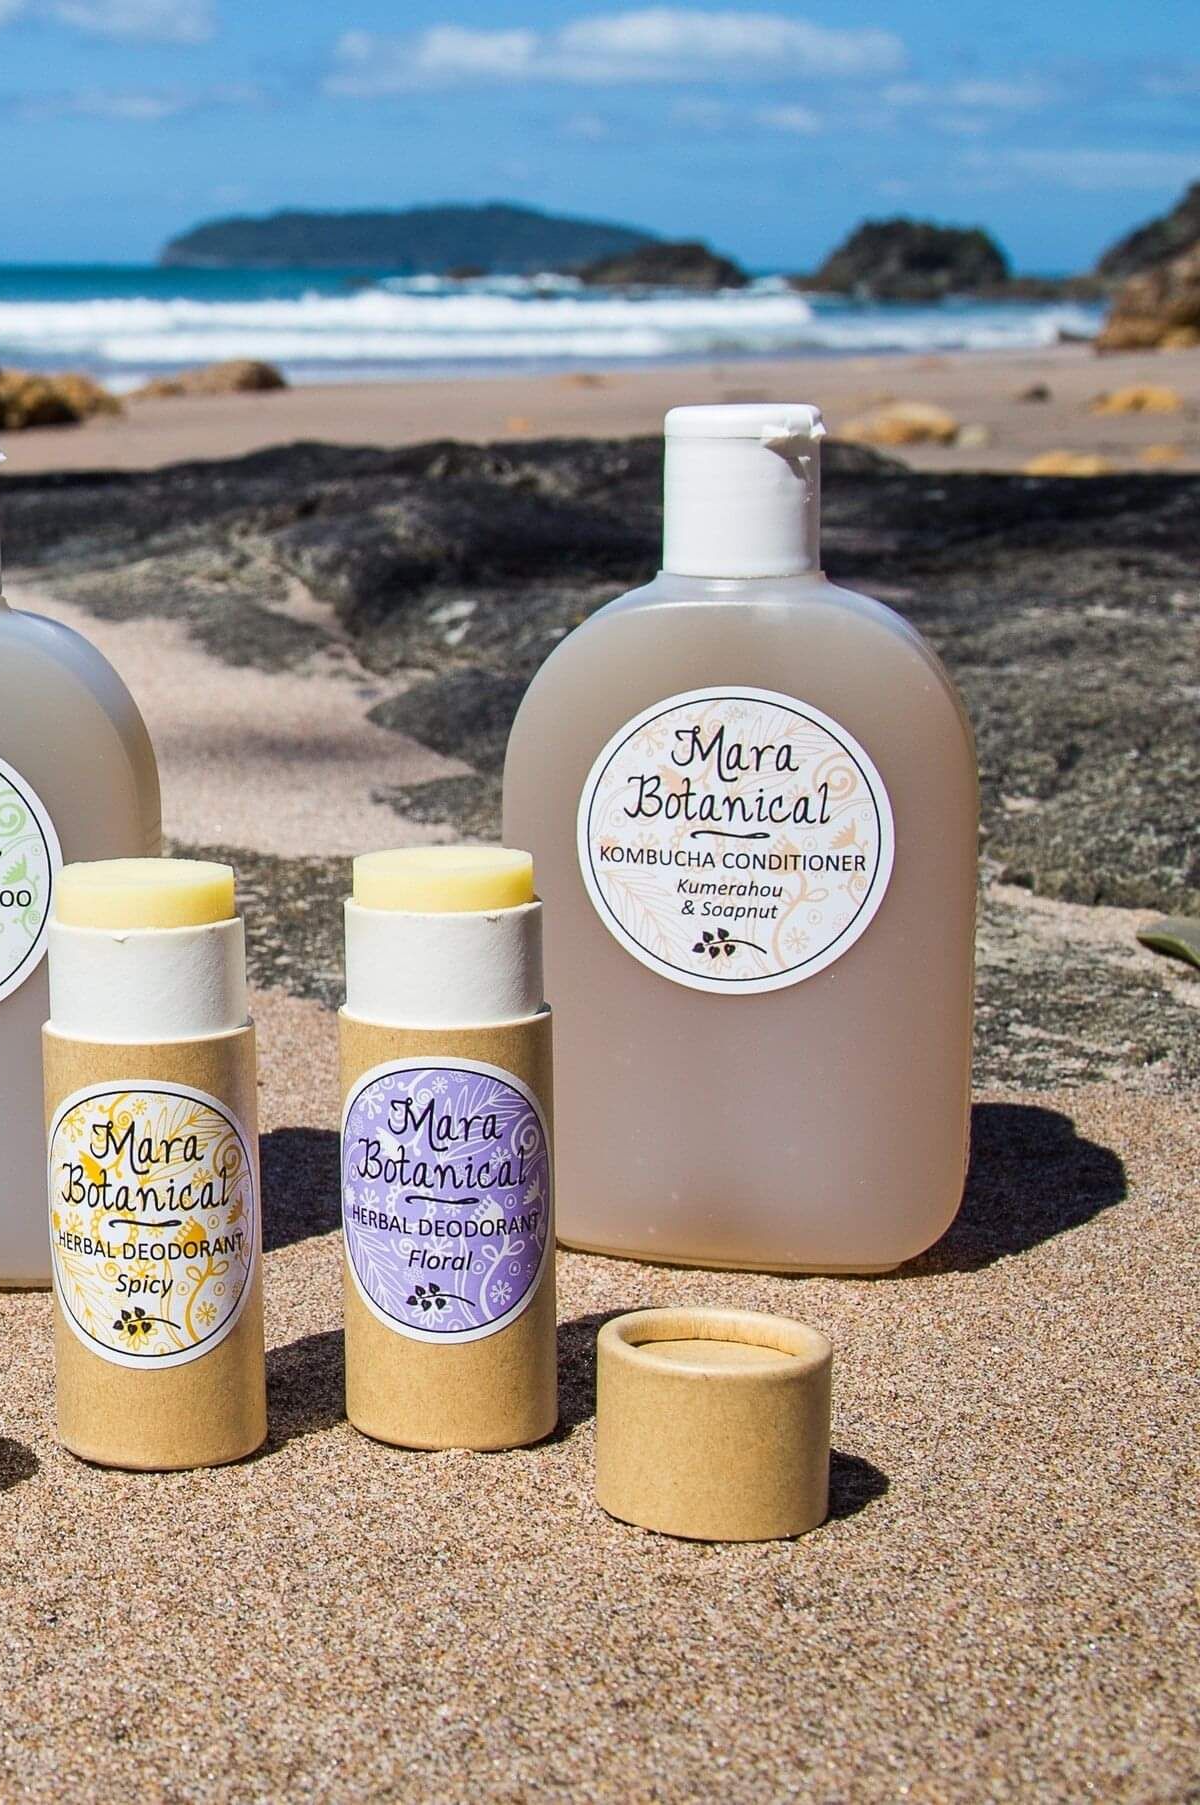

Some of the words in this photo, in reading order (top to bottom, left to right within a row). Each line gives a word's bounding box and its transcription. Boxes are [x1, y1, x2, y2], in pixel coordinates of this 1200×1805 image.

[671, 725, 799, 782] Mara
[623, 774, 831, 824] Botanical
[600, 846, 715, 868] KOMBUCHA
[723, 853, 866, 872] CONDITIONER
[677, 878, 783, 898] Kumerahou
[681, 900, 695, 915] &
[701, 901, 778, 921] Soapnut
[387, 1097, 503, 1152] Mara
[90, 1121, 204, 1175] Mara
[356, 1137, 526, 1189] Botanical
[62, 1162, 229, 1211] Botanical
[352, 1204, 412, 1235] HERBAL
[419, 1212, 540, 1238] DEODORANT
[59, 1231, 116, 1259] HERBAL
[123, 1232, 245, 1260] DEODORANT
[408, 1249, 473, 1271] Floral
[115, 1273, 173, 1298] Spicy
